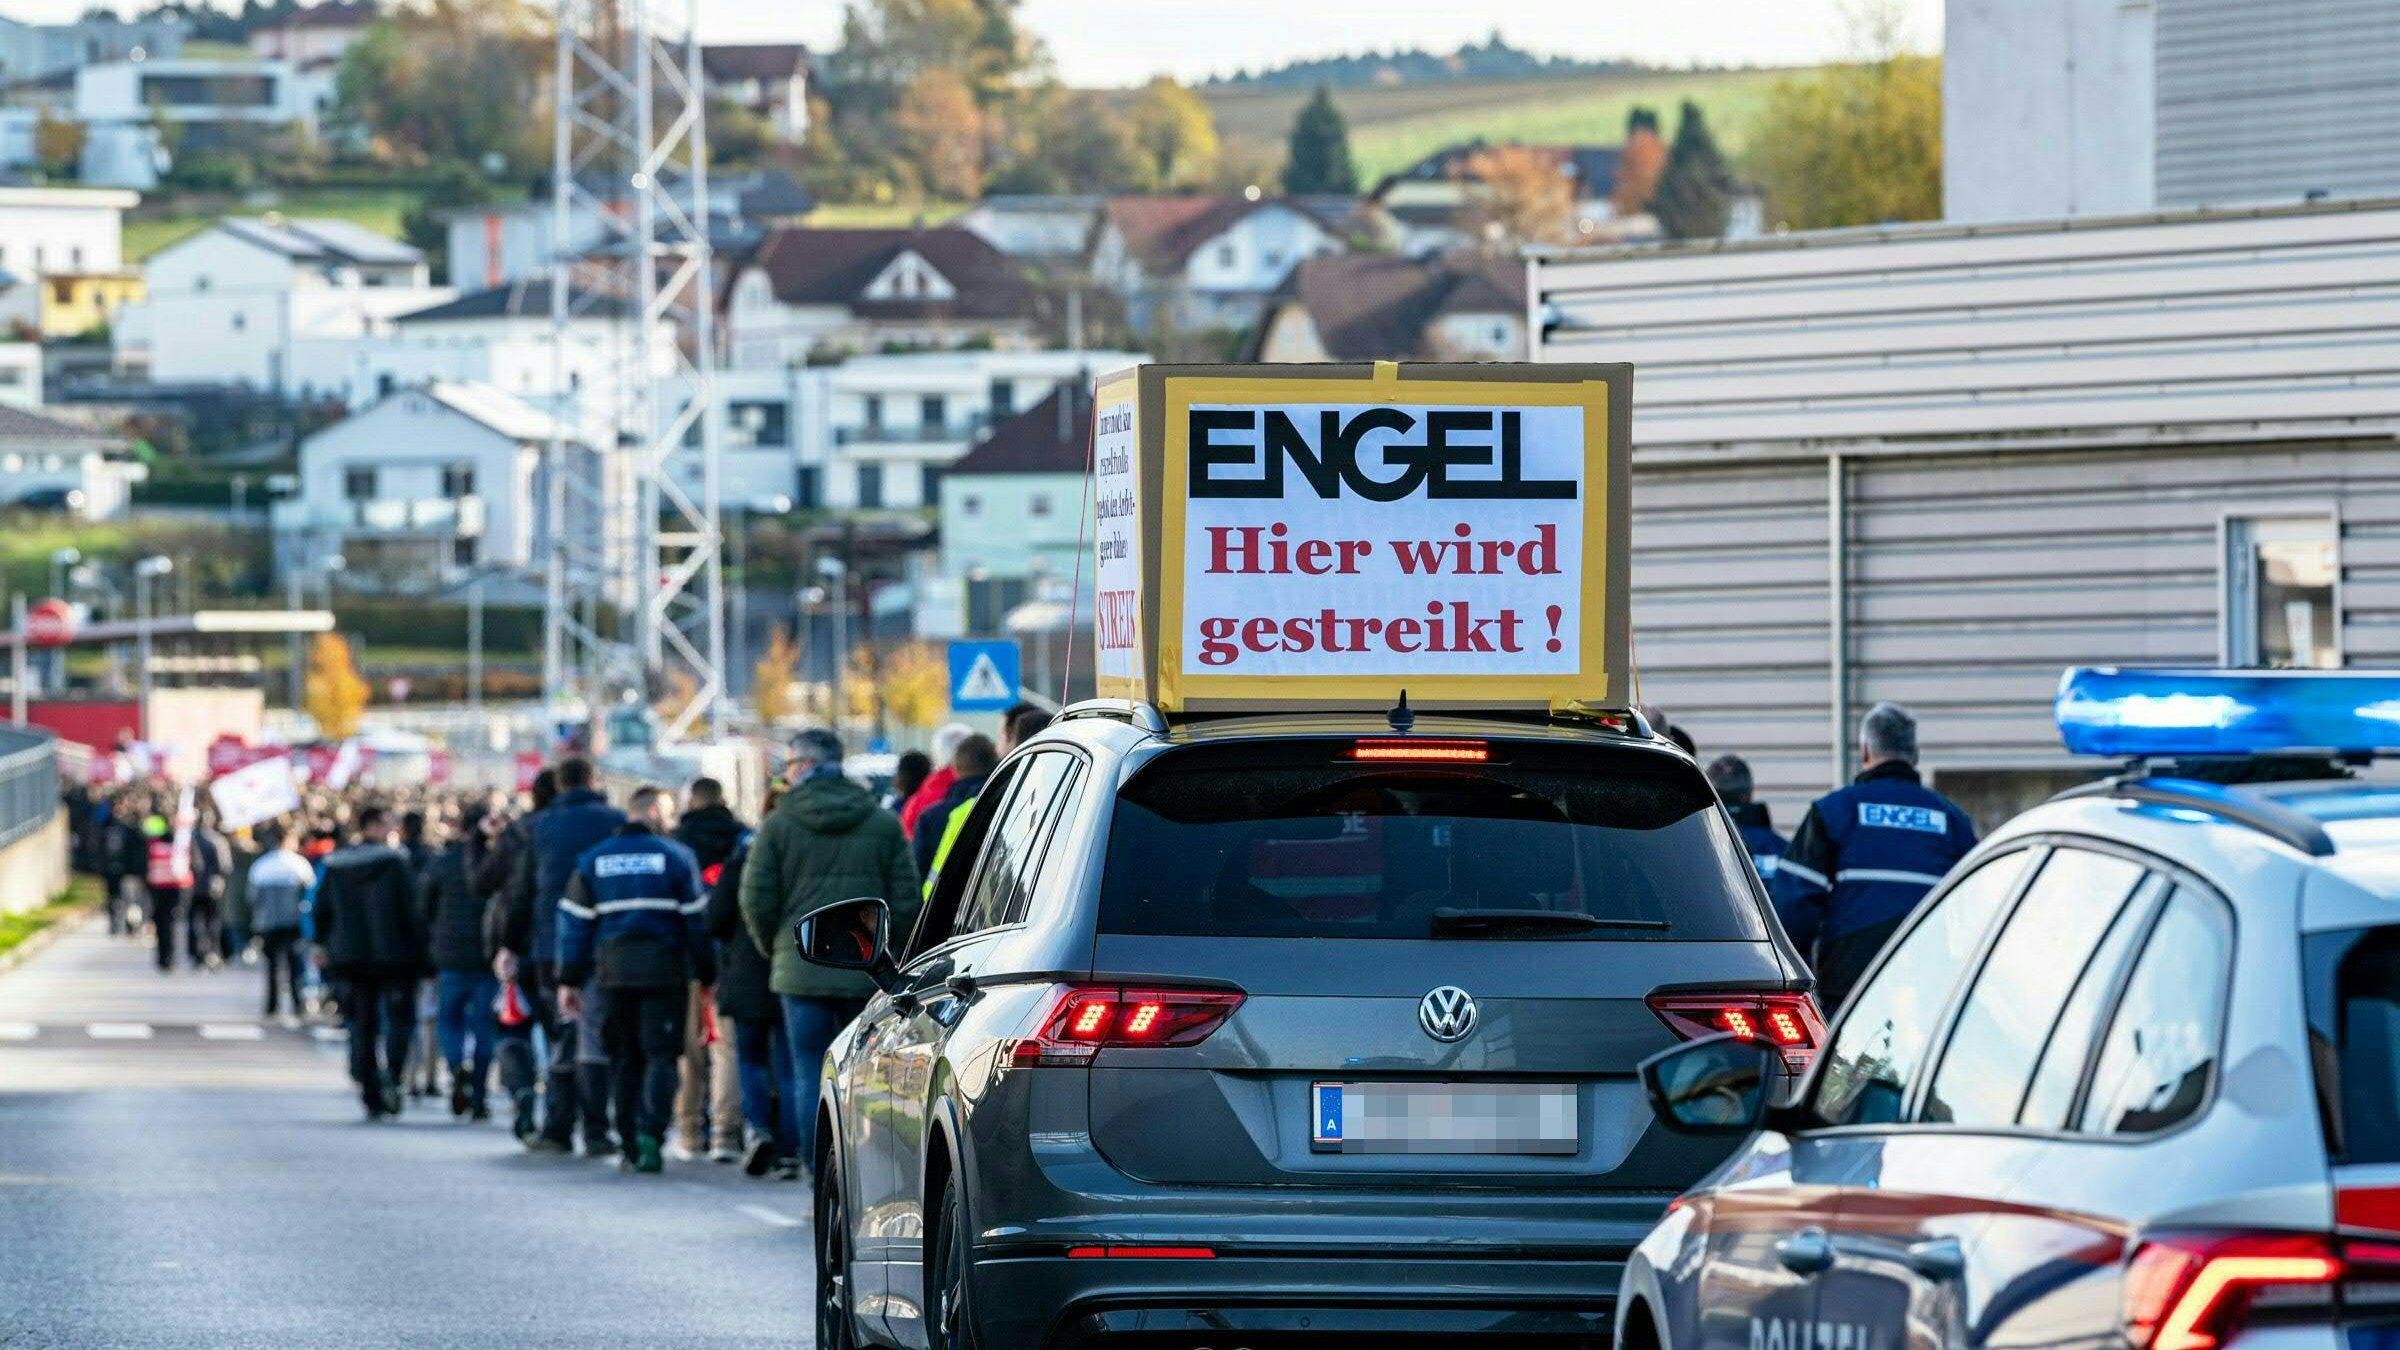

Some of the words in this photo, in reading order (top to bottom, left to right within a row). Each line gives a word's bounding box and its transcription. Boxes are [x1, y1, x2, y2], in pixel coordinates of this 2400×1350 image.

[1189, 408, 1578, 502] ENGEL
[1204, 522, 1372, 575] Hier
[1389, 522, 1562, 575] wird
[1098, 590, 1136, 649] STREIK
[1198, 601, 1524, 666] gestreikt
[1545, 604, 1563, 653] !
[1865, 805, 1942, 833] ENGEL
[1326, 1119, 1337, 1131] A
